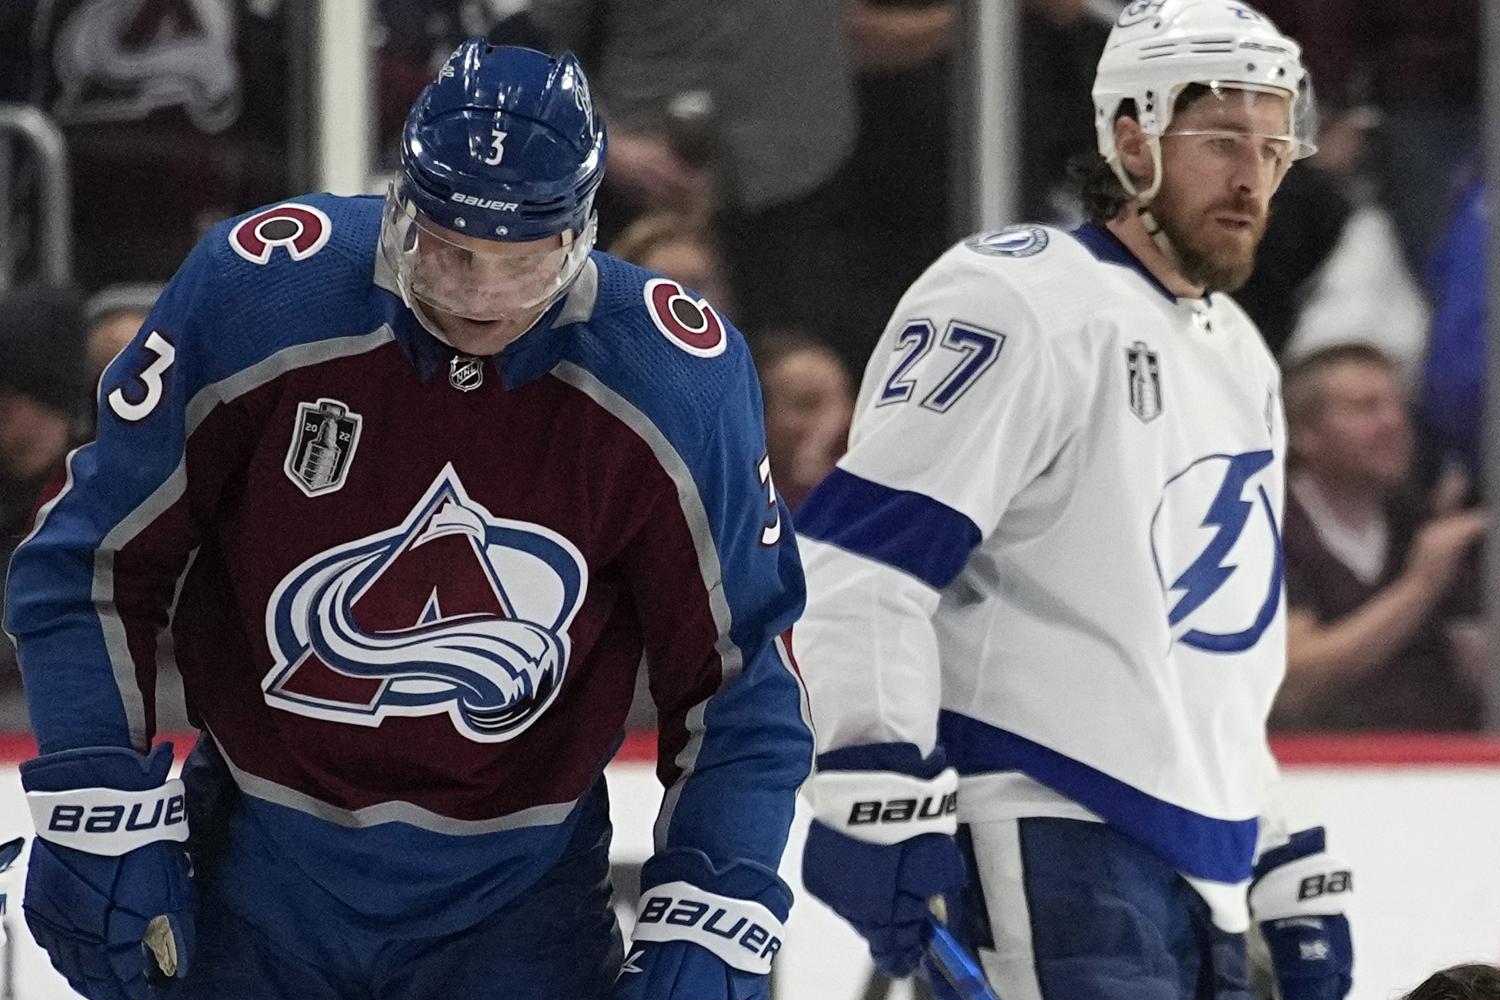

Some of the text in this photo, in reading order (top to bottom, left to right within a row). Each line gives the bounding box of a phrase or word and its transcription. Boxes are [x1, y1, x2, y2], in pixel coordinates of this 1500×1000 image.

[484, 129, 508, 167] 3
[450, 191, 520, 213] BAUER
[107, 330, 176, 421] 3
[456, 365, 476, 384] NHL
[875, 317, 1007, 416] 27
[304, 422, 351, 442] 20 22
[757, 454, 781, 545] 3
[47, 794, 187, 833] BAUE
[1296, 870, 1354, 904] BA
[638, 896, 782, 964] BAUER
